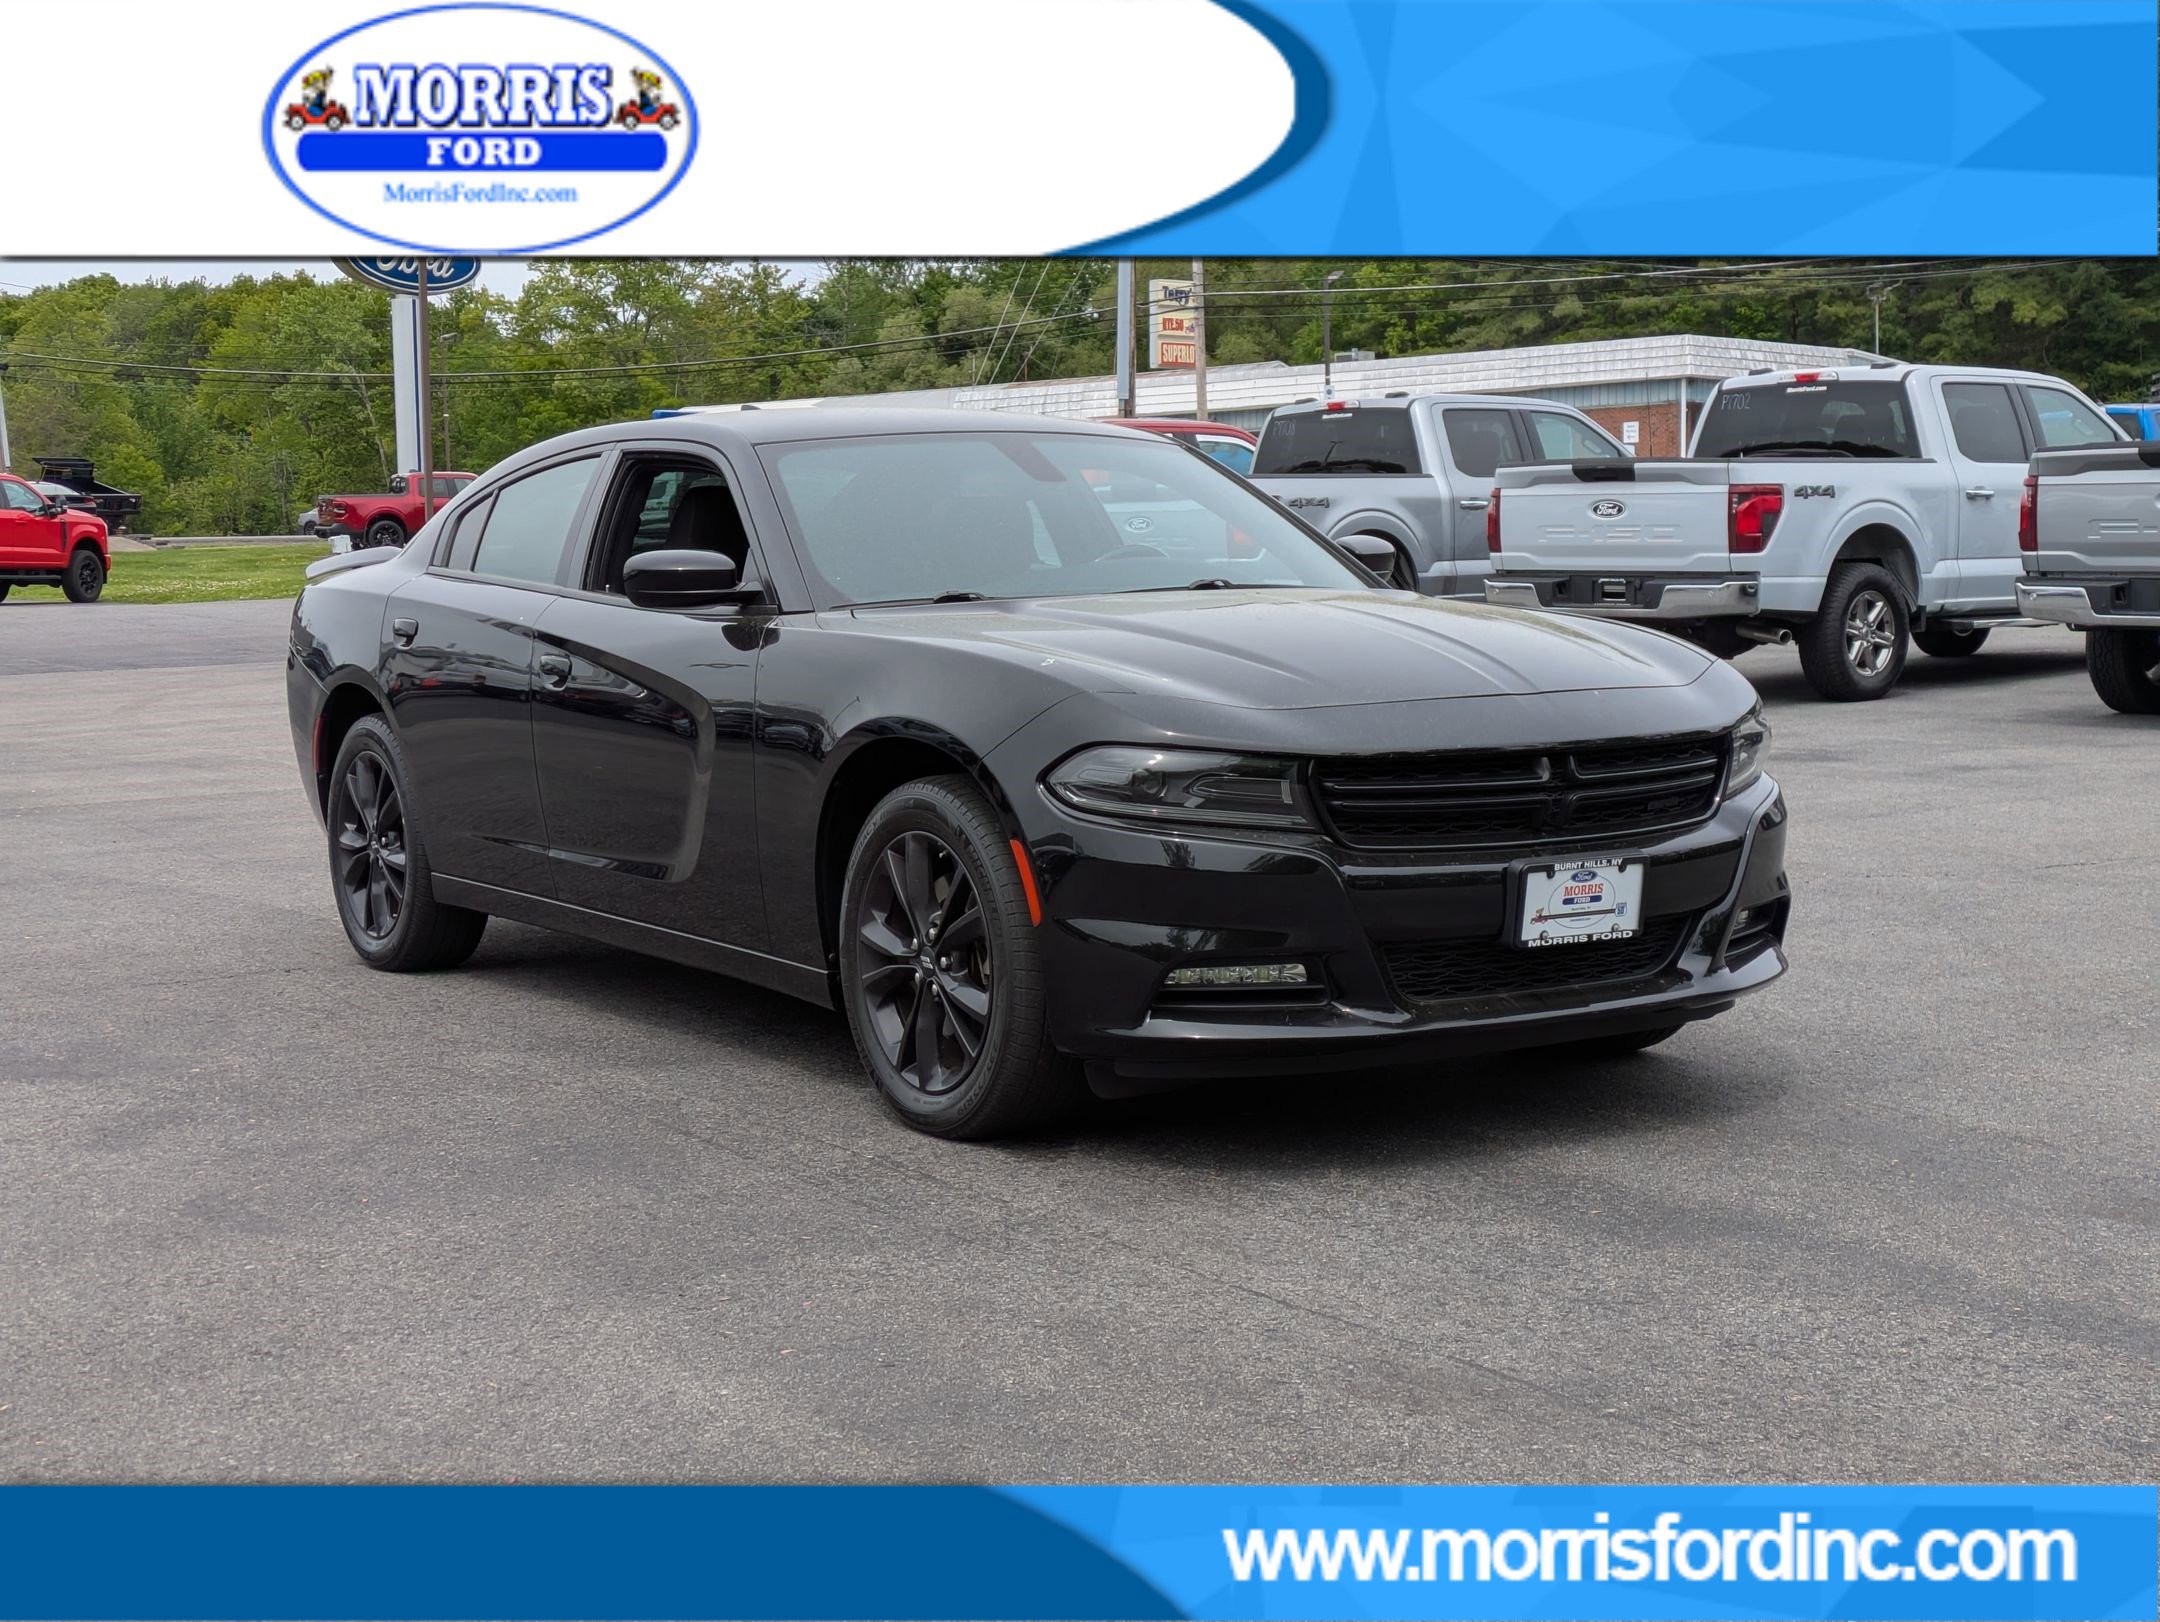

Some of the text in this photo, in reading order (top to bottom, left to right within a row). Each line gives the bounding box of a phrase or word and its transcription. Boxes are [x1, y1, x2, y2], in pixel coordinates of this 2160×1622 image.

[1595, 502, 1621, 516] Ford
[1554, 861, 1583, 871] BURNT
[1611, 858, 1623, 867] NY
[1563, 883, 1604, 897] MORRIS
[1573, 896, 1591, 904] FORD
[1528, 930, 1633, 948] MORRIS FORD
